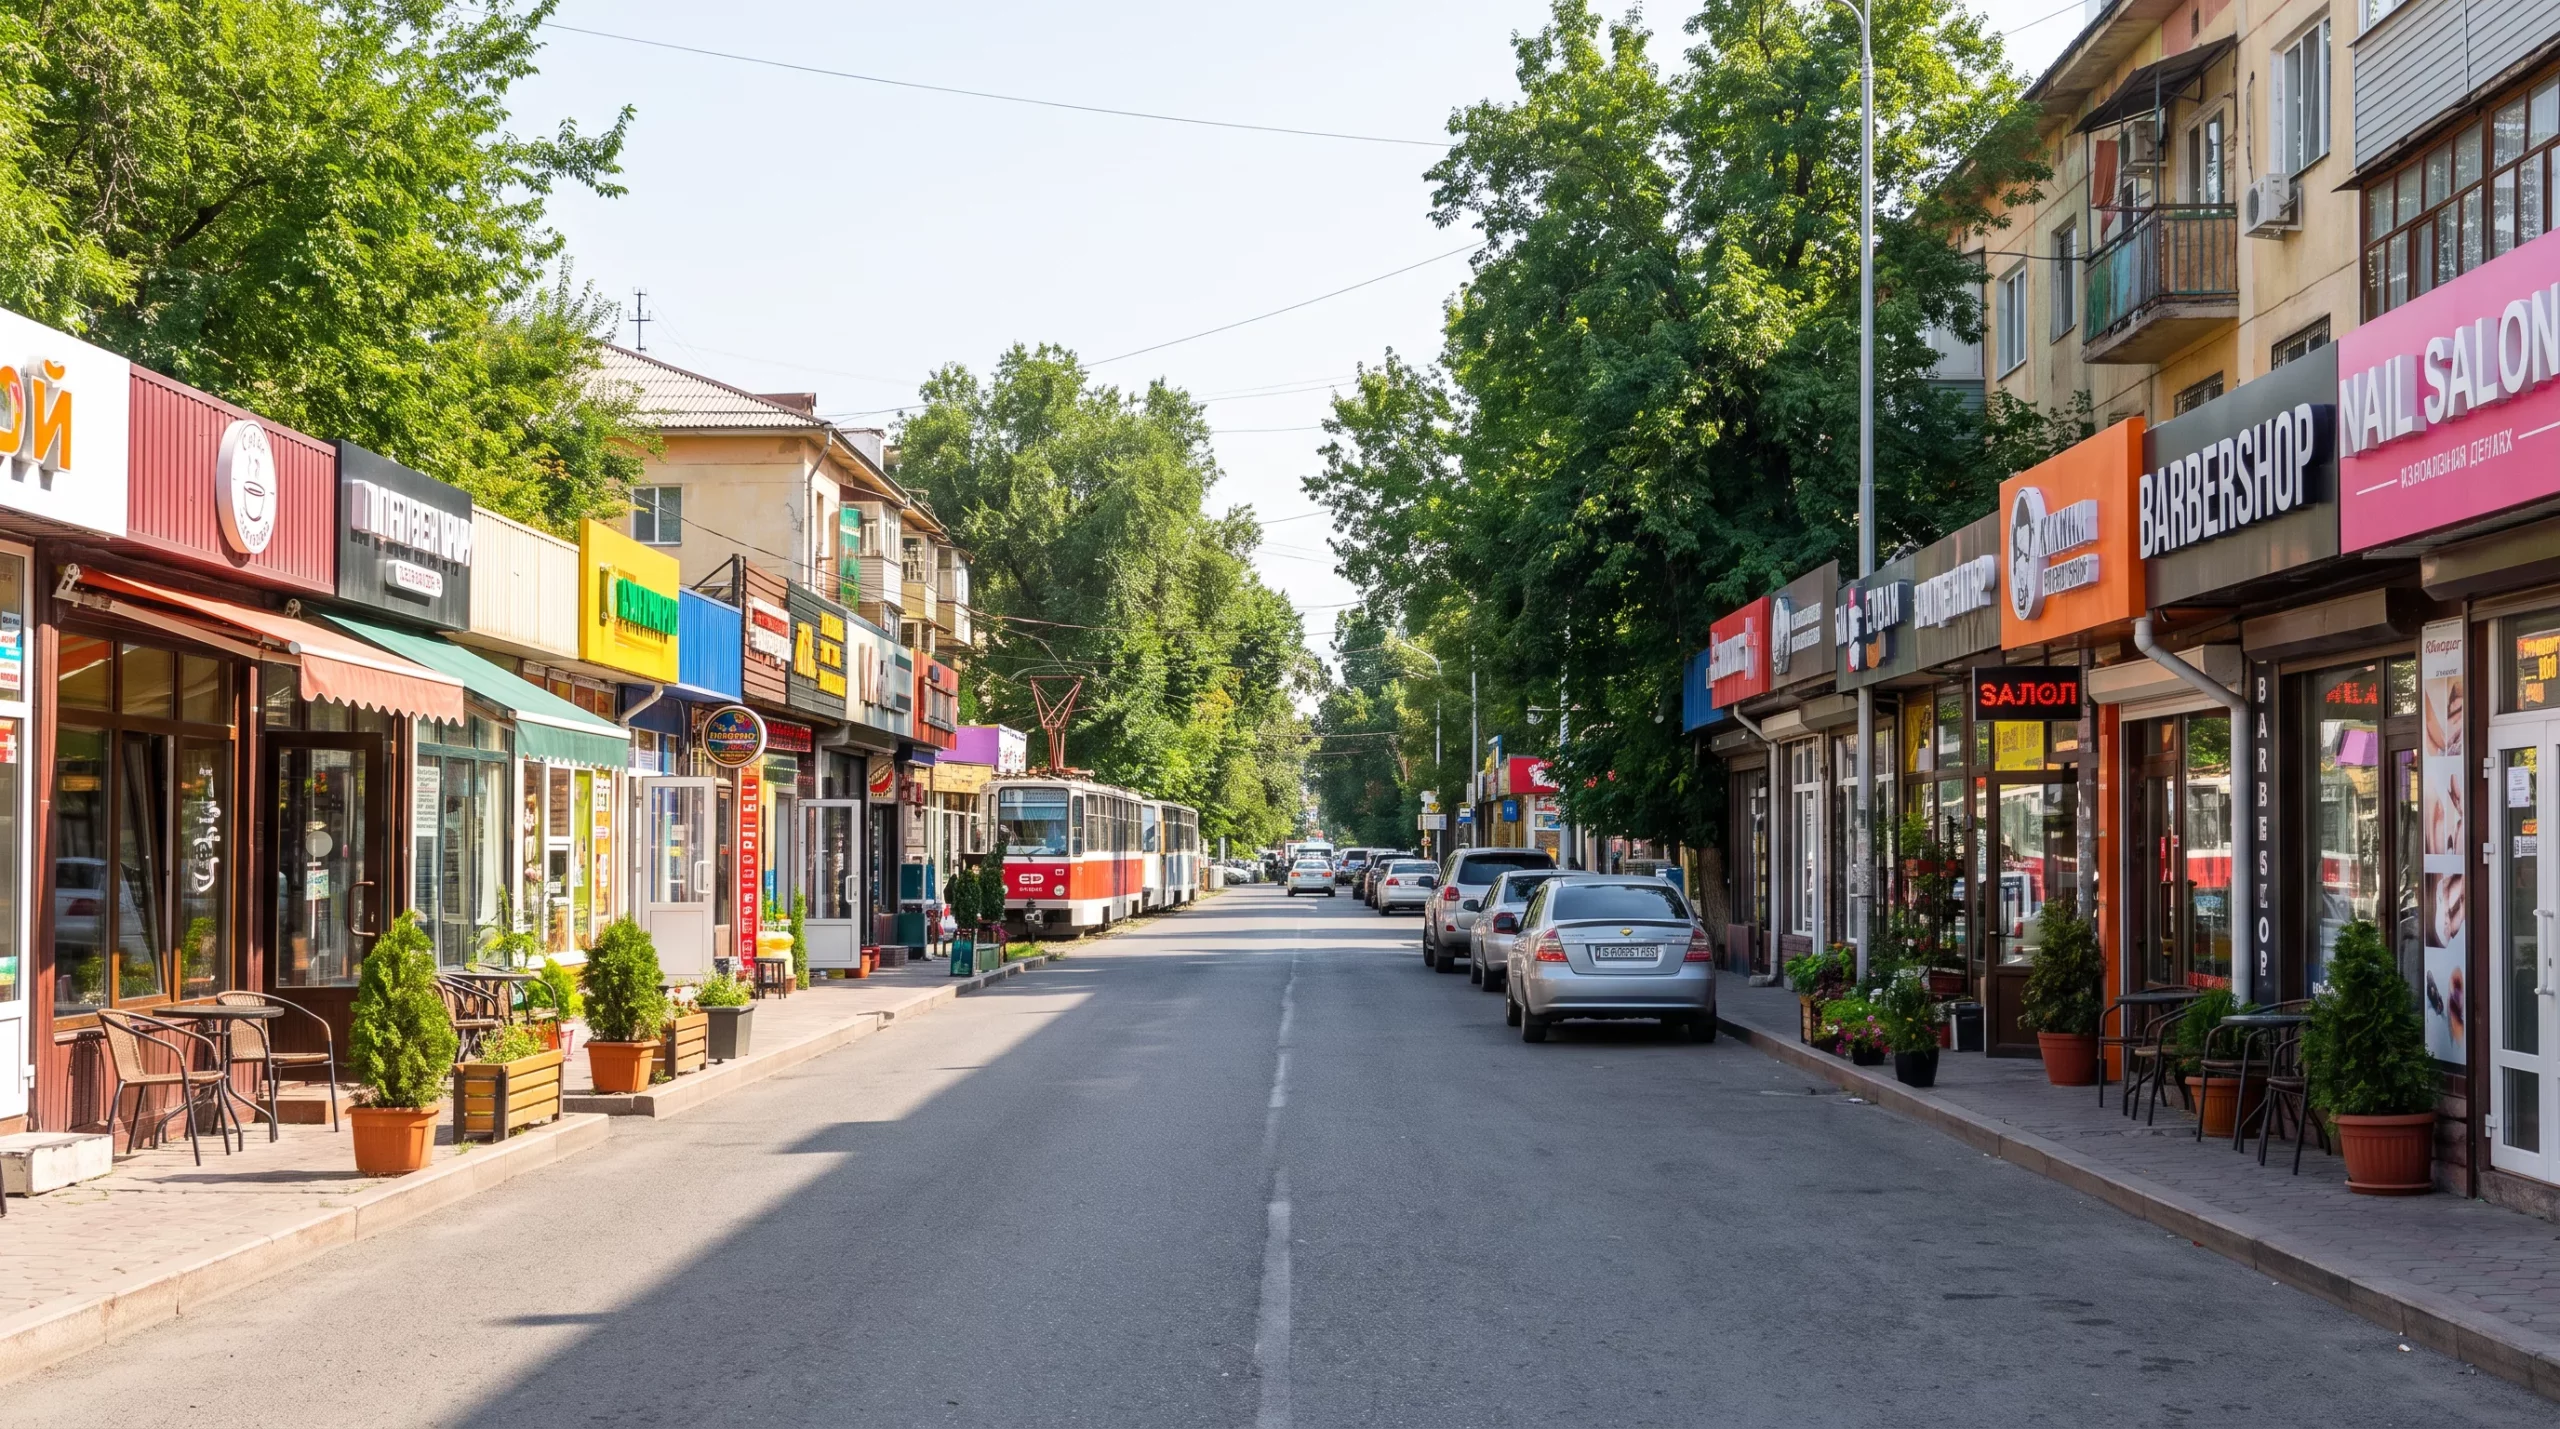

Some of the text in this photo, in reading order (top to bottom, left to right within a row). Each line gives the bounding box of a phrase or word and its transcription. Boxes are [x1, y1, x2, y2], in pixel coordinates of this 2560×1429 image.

[2339, 282, 2560, 459] NAIL SALON
[2139, 402, 2314, 560] BARBERSHOP
